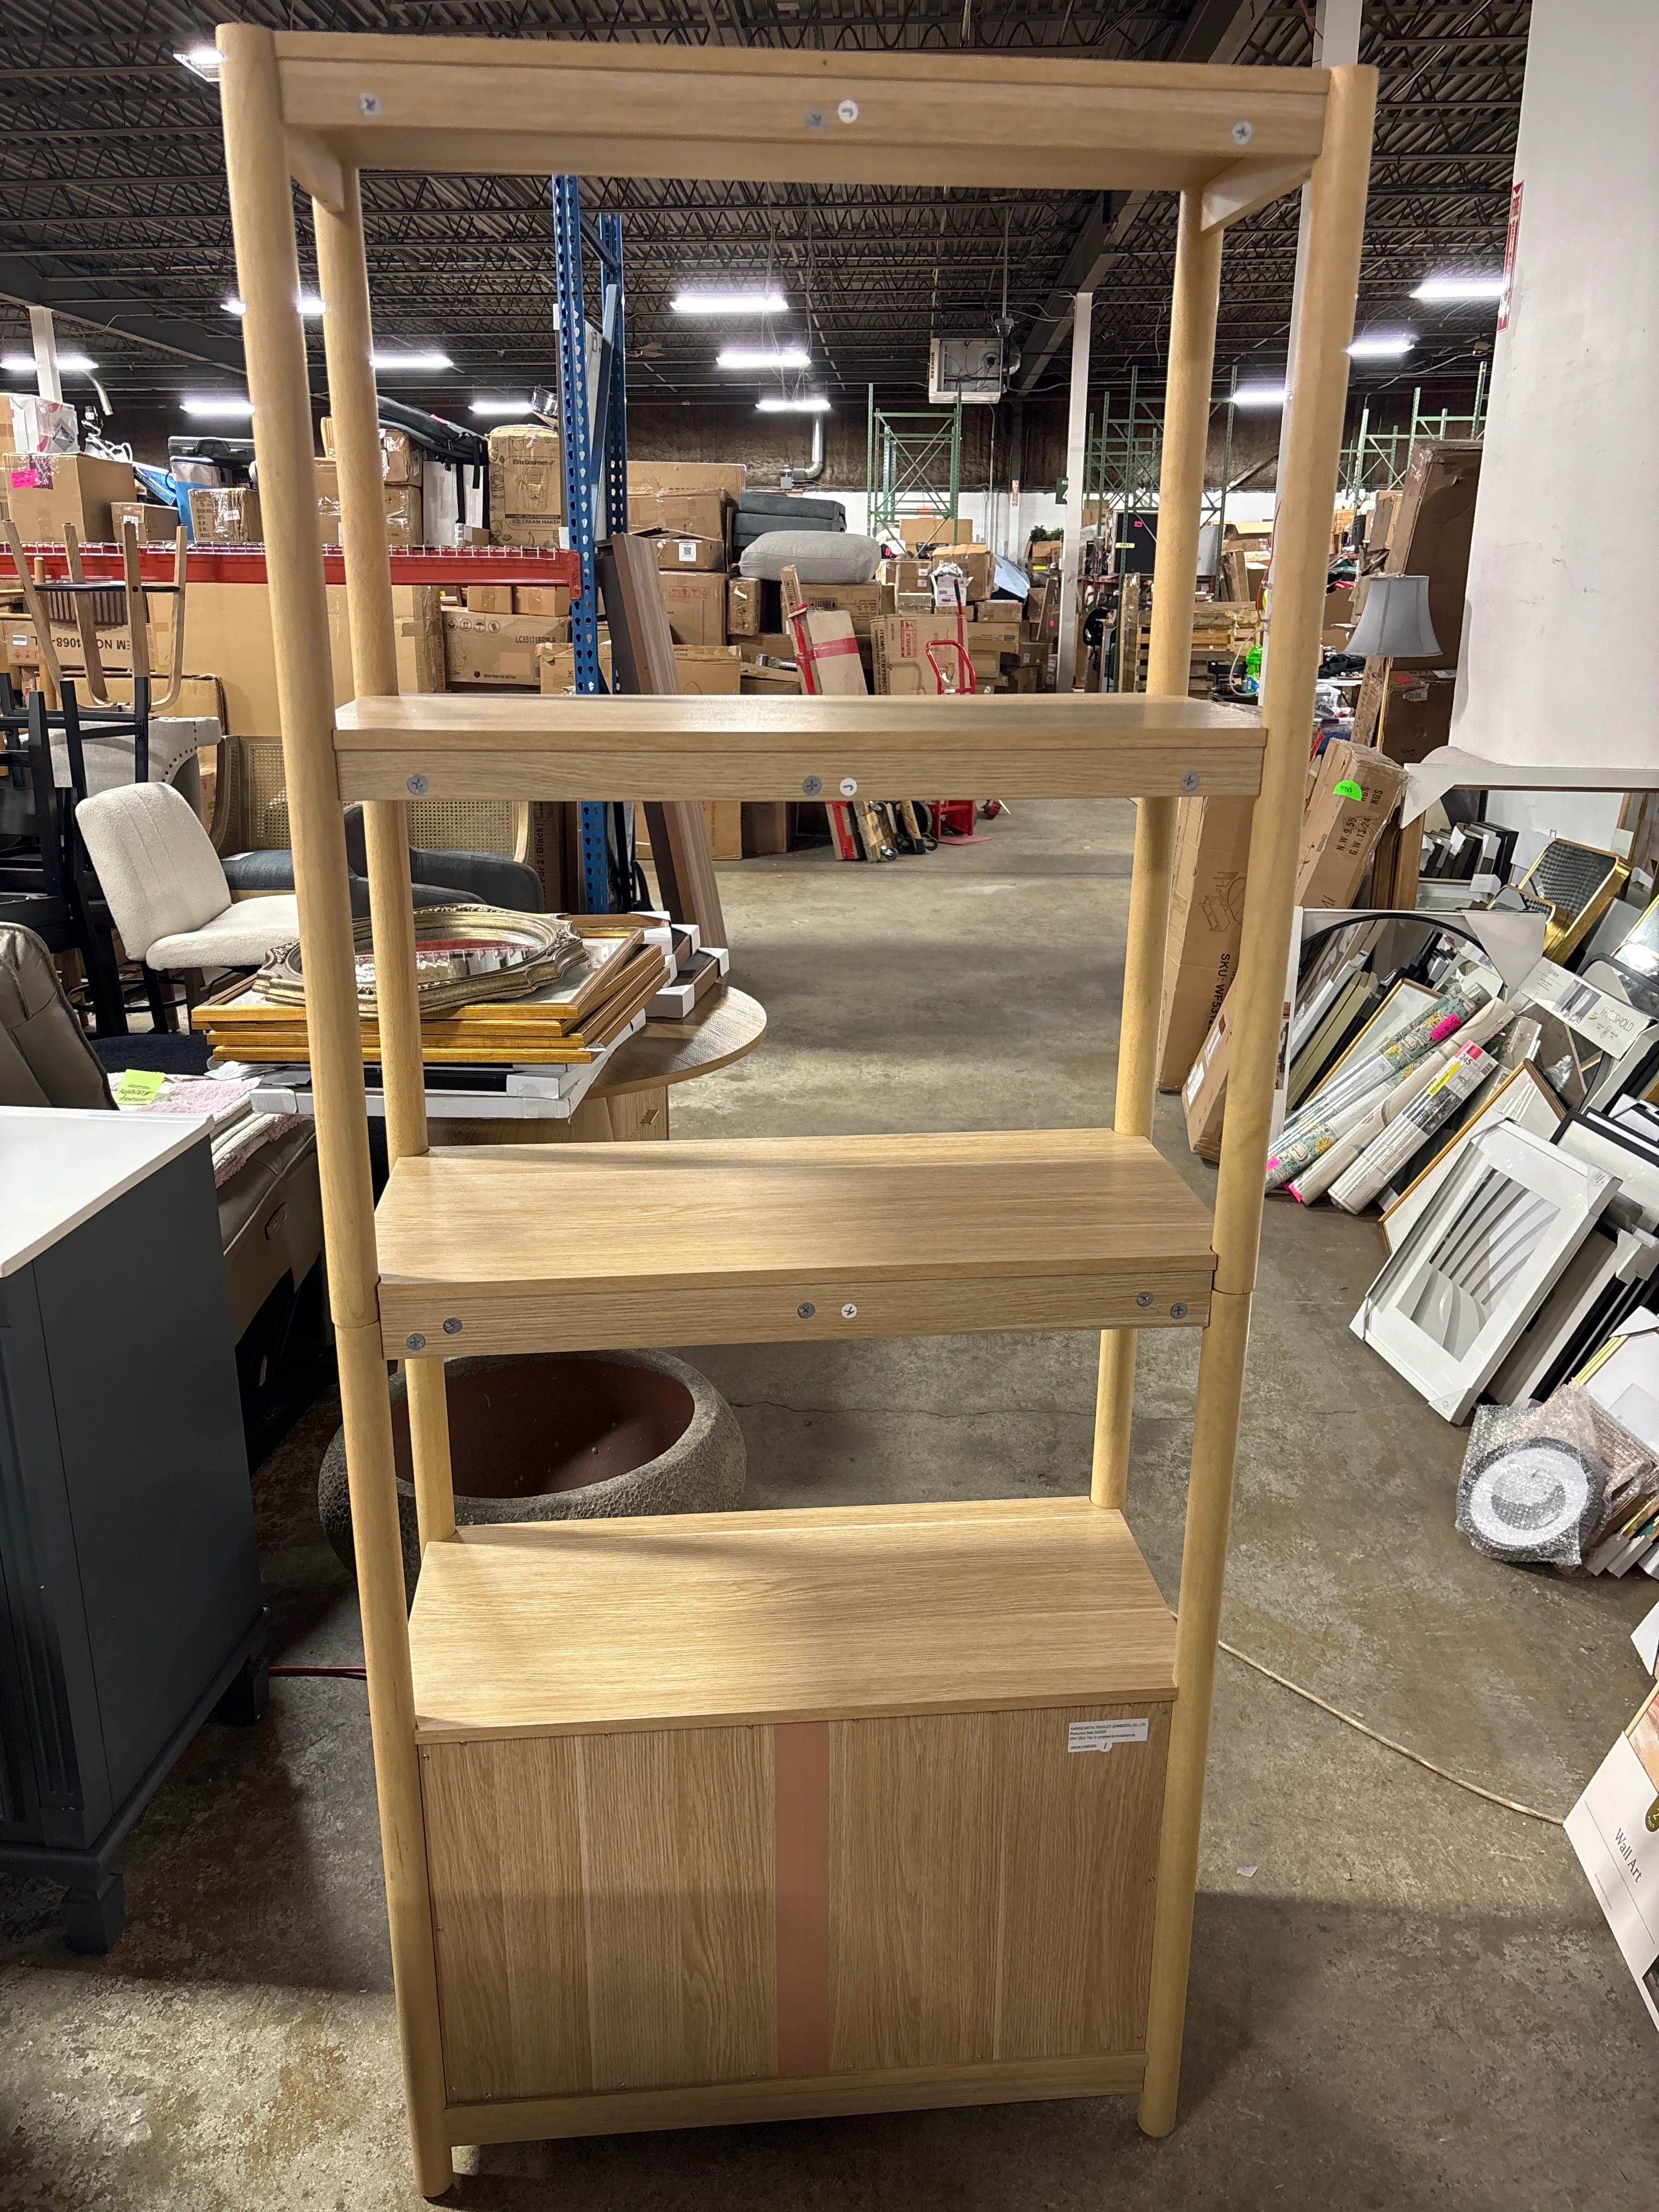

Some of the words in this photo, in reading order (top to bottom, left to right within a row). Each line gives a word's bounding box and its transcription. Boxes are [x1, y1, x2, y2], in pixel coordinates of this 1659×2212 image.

[1369, 789, 1383, 805] KGS
[535, 823, 545, 858] (Black)
[537, 859, 545, 868] 2
[1217, 953, 1231, 980] SKU:
[1600, 1006, 1634, 1032] THRESHOLD
[1459, 1053, 1473, 1066] 245
[1615, 1827, 1633, 1861] Wall
[1627, 1859, 1643, 1883] Art
